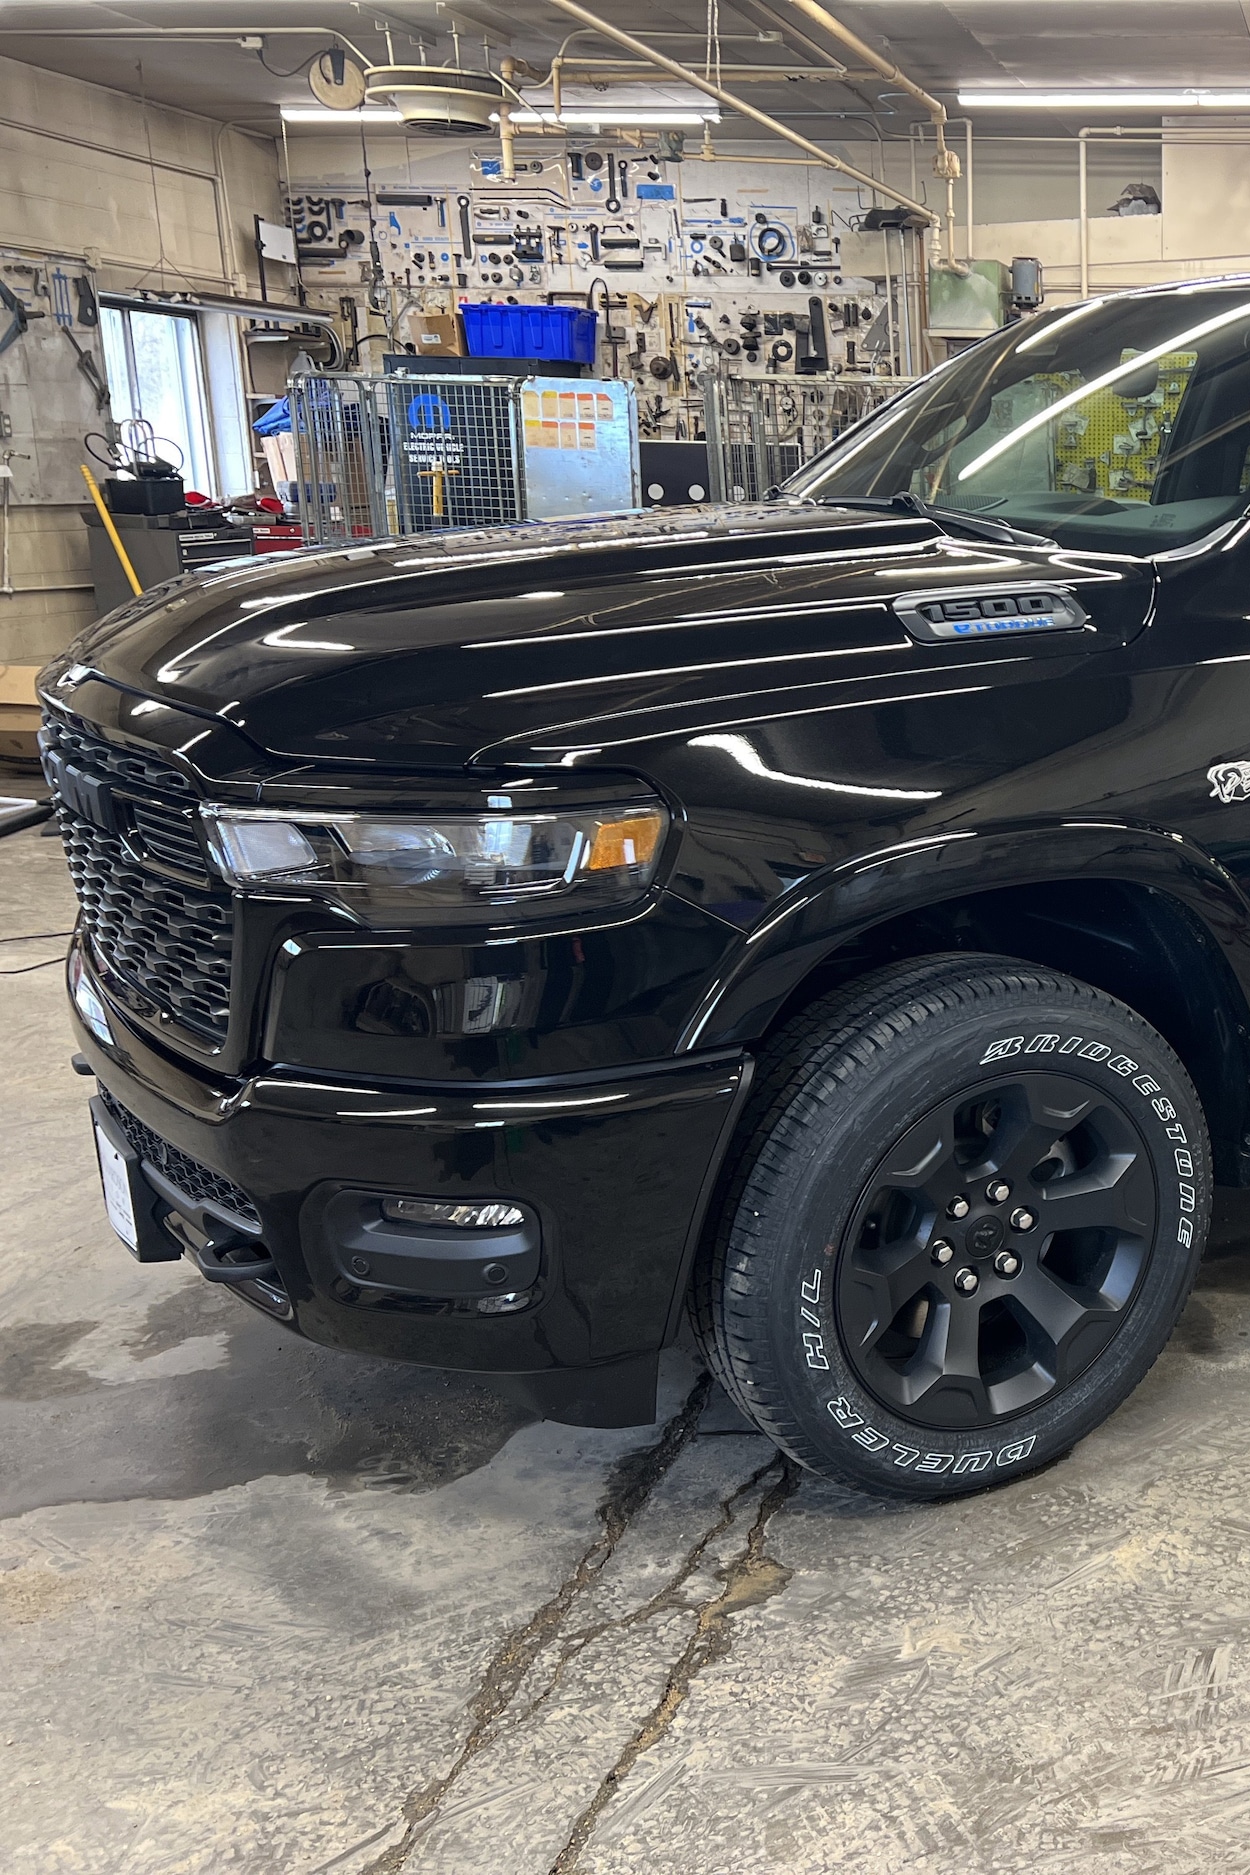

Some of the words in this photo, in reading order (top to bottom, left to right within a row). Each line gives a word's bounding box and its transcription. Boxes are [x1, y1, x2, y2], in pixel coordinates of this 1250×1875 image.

[921, 595, 1053, 623] 1500
[979, 1034, 1196, 1249] BRIDGESTONE
[801, 1268, 831, 1371] H/L
[825, 1395, 1037, 1475] DUELER
